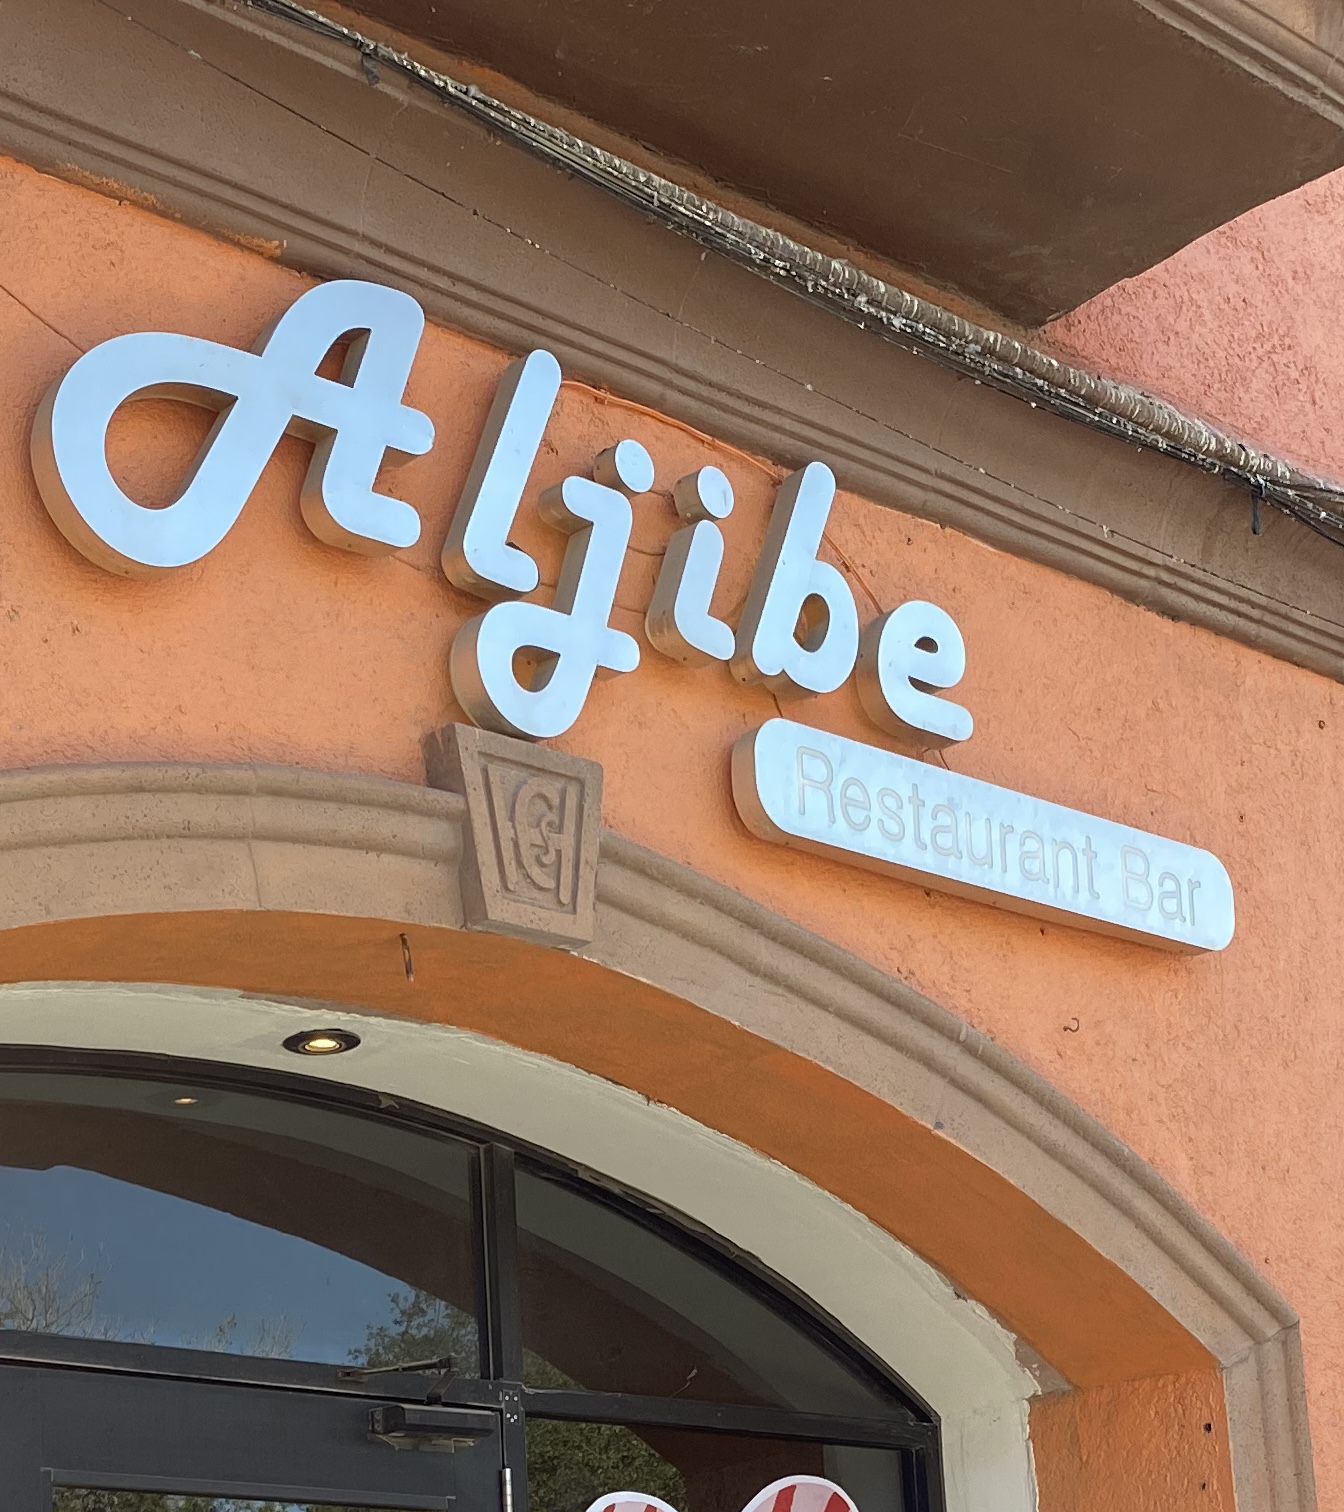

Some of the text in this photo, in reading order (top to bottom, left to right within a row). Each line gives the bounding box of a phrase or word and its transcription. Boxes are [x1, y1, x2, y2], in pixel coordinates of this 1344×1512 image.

[44, 278, 975, 740] Aljibe
[794, 746, 1203, 929] Restaurant Bar
